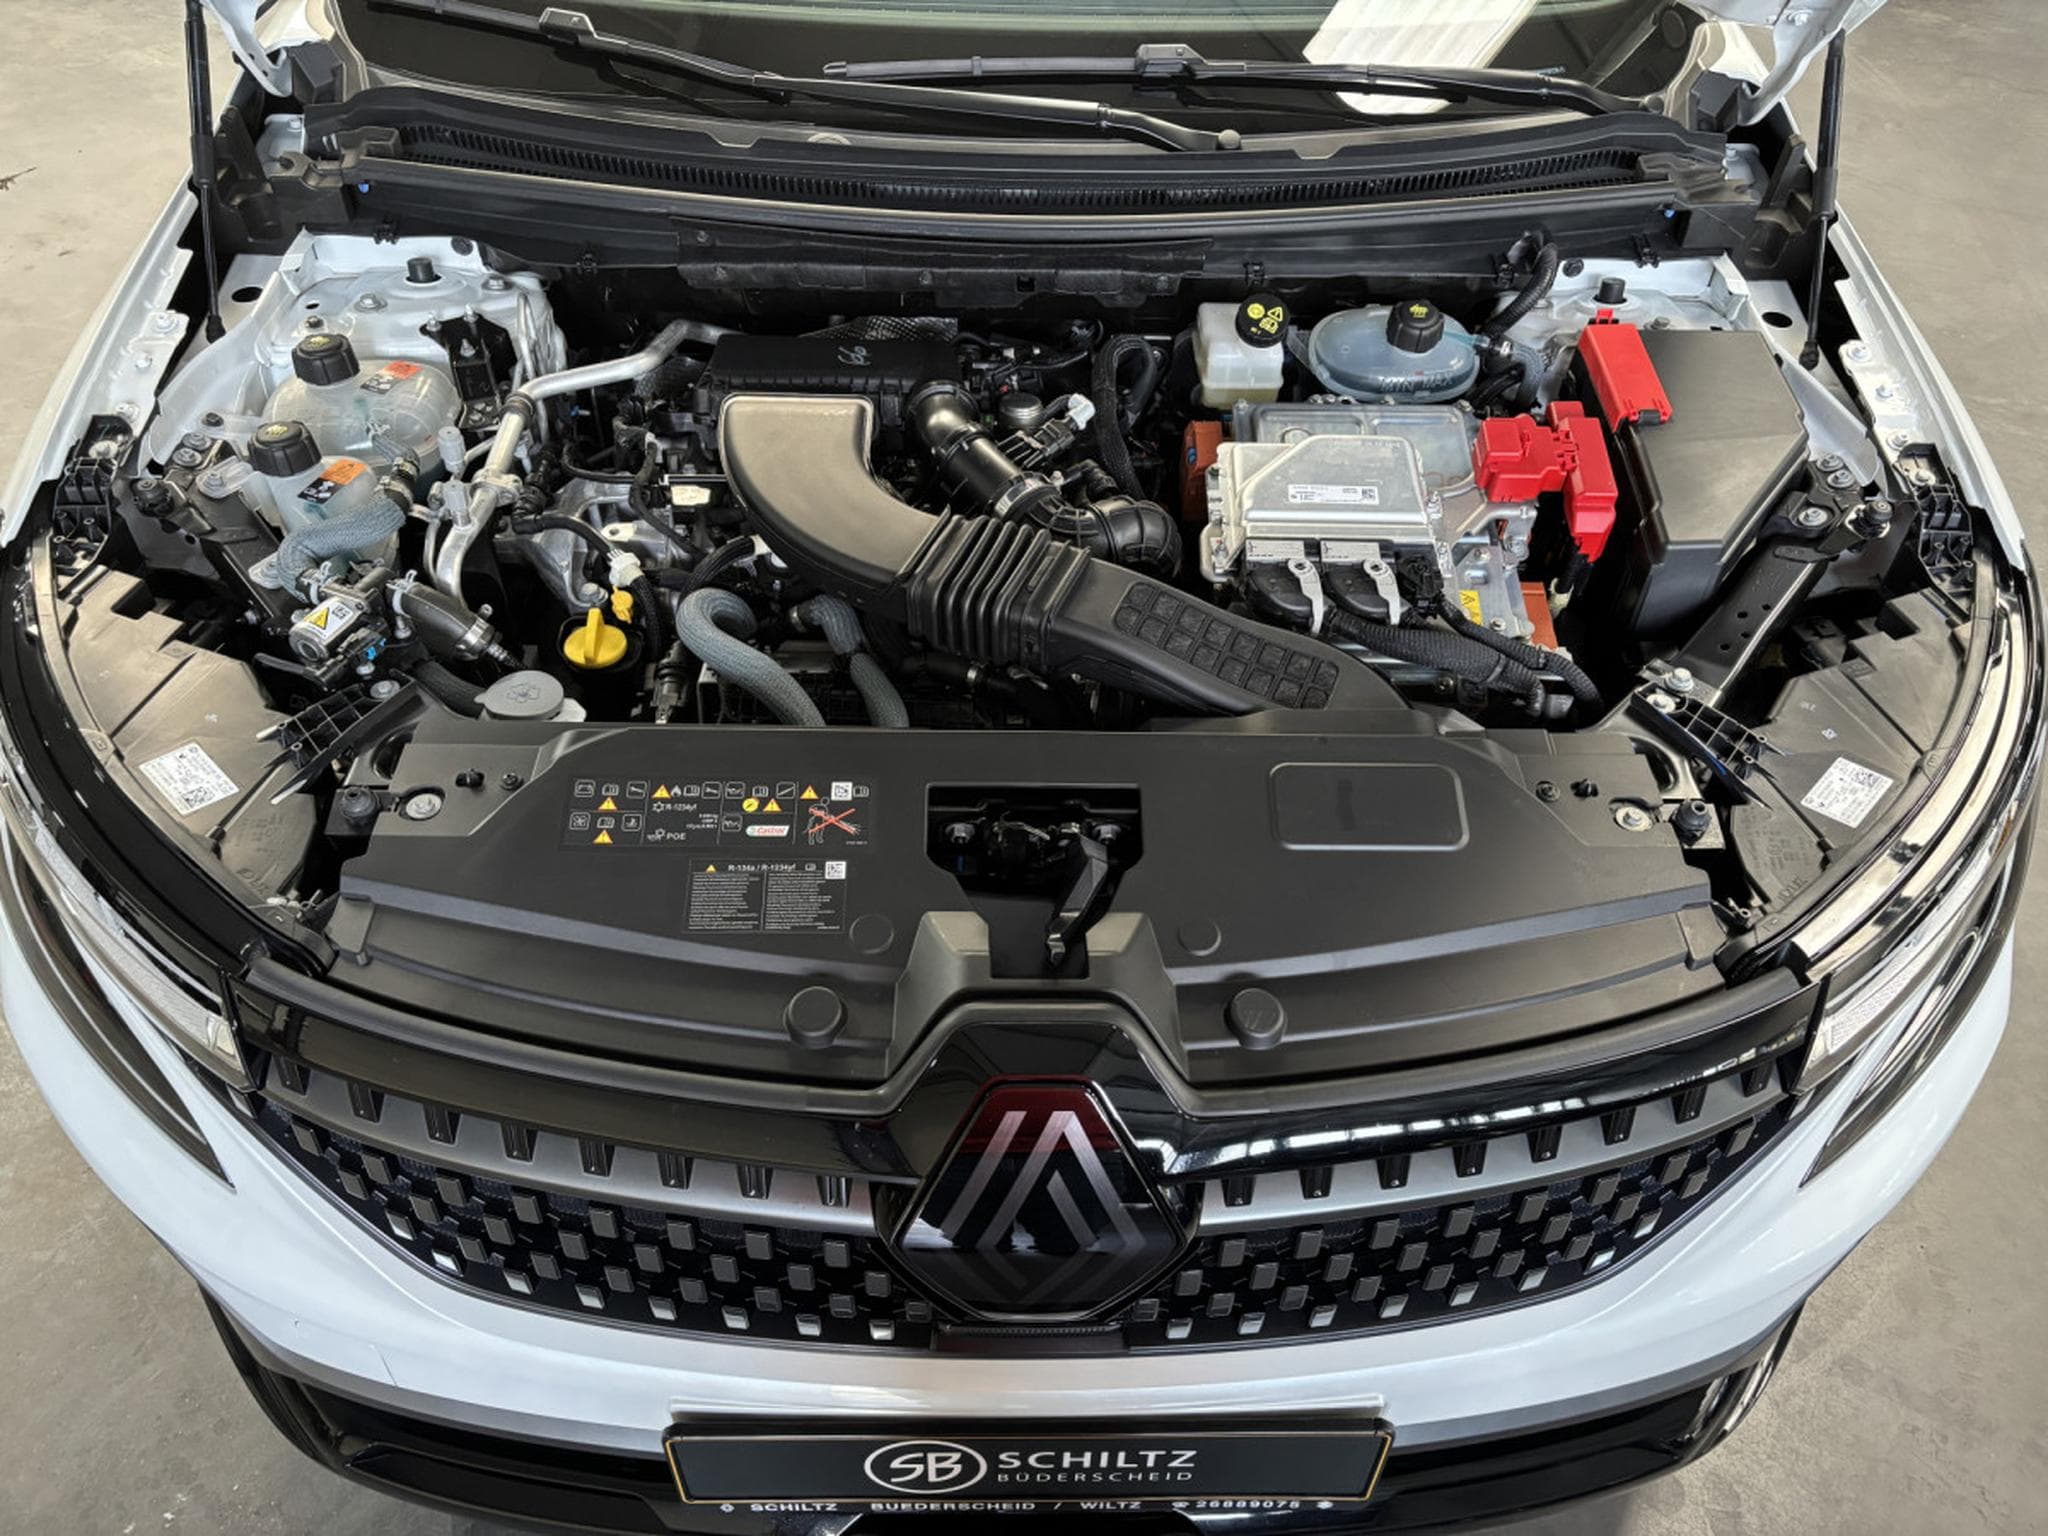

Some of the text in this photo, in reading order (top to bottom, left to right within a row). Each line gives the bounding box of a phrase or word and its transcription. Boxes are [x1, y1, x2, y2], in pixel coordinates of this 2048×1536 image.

[666, 832, 687, 840] POE
[998, 1450, 1197, 1469] SCHILTZ
[889, 1451, 962, 1483] SB
[997, 1471, 1193, 1482] BÜDERSCHEID
[750, 1502, 838, 1512] SCHILTZ
[870, 1502, 1036, 1512] BUEDERSCHEID
[1080, 1501, 1142, 1510] WILTZ
